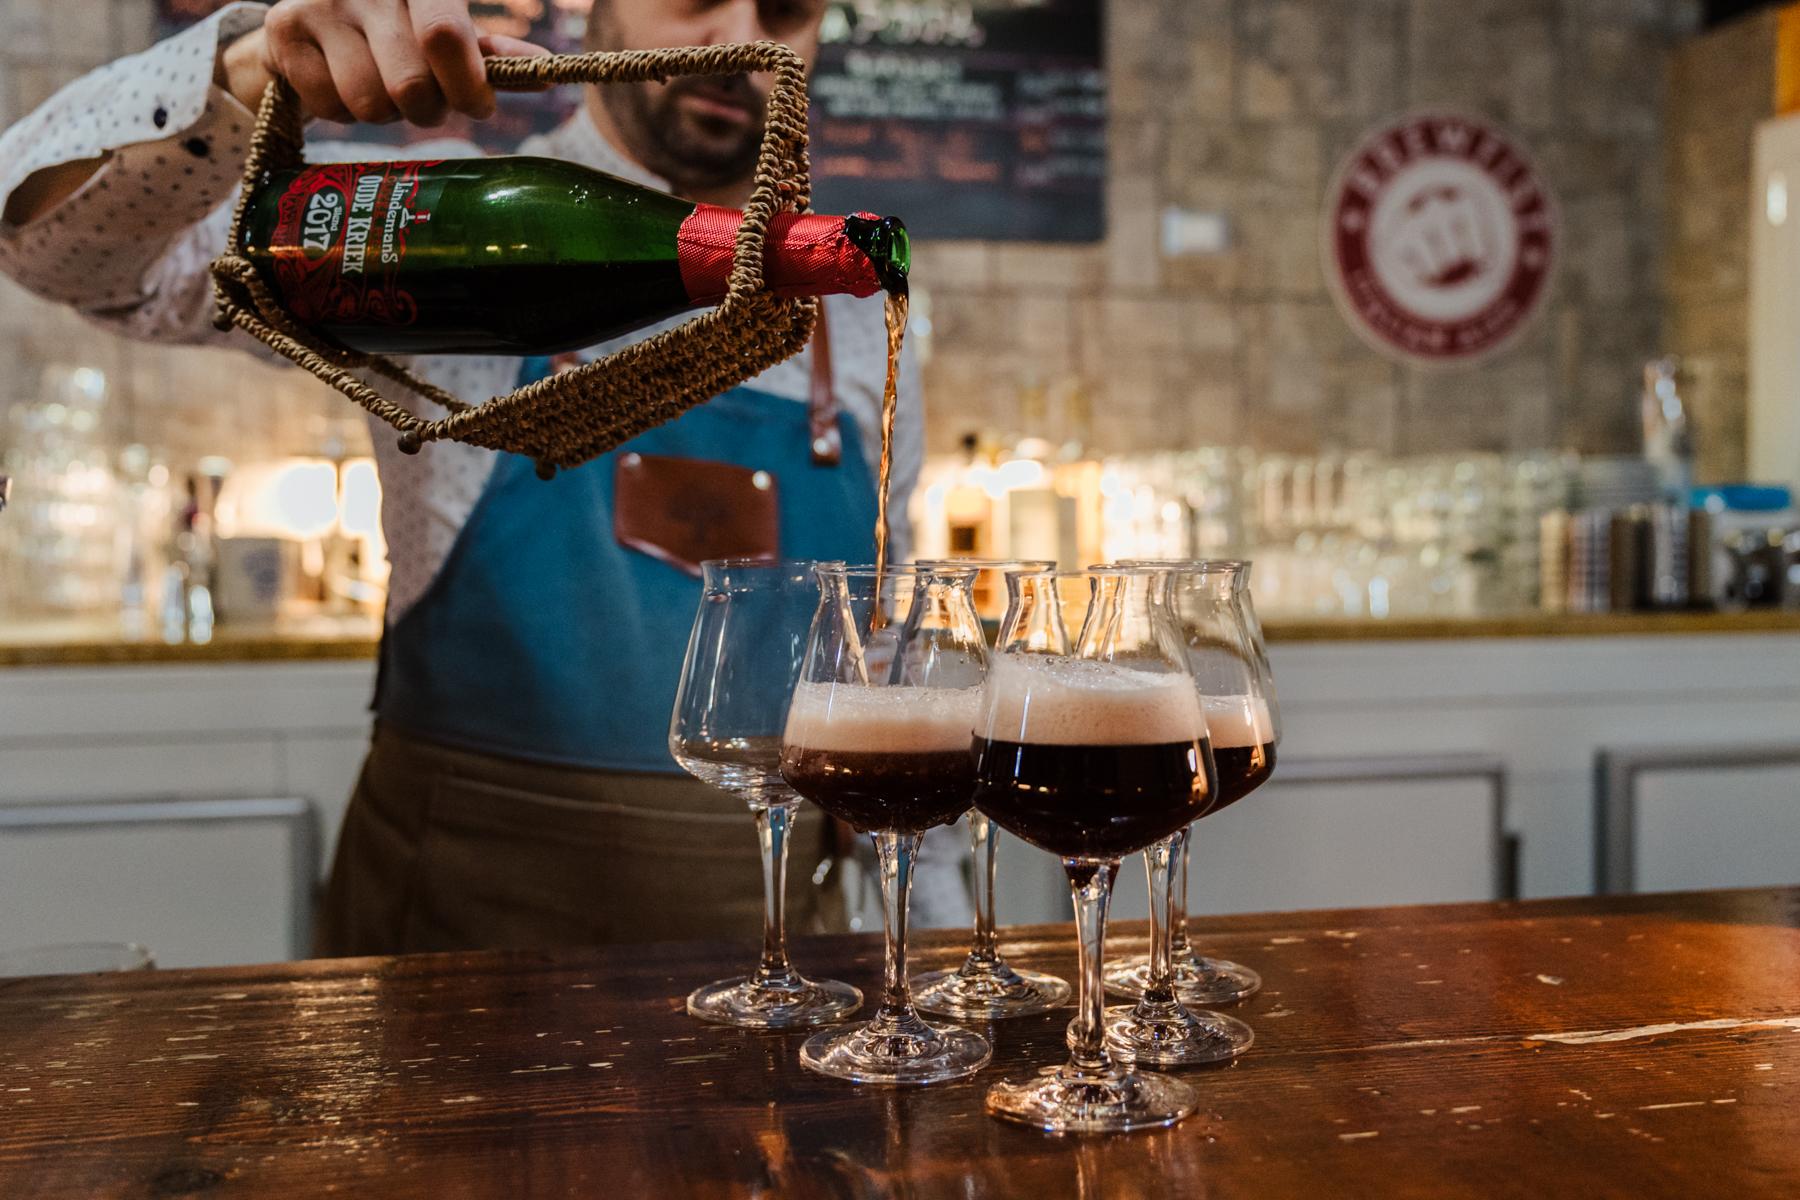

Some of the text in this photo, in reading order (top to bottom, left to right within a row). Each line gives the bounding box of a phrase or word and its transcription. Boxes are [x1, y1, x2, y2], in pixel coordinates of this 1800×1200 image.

[303, 193, 338, 251] 2017
[352, 175, 384, 212] OUDE
[342, 216, 373, 274] KRIEK
